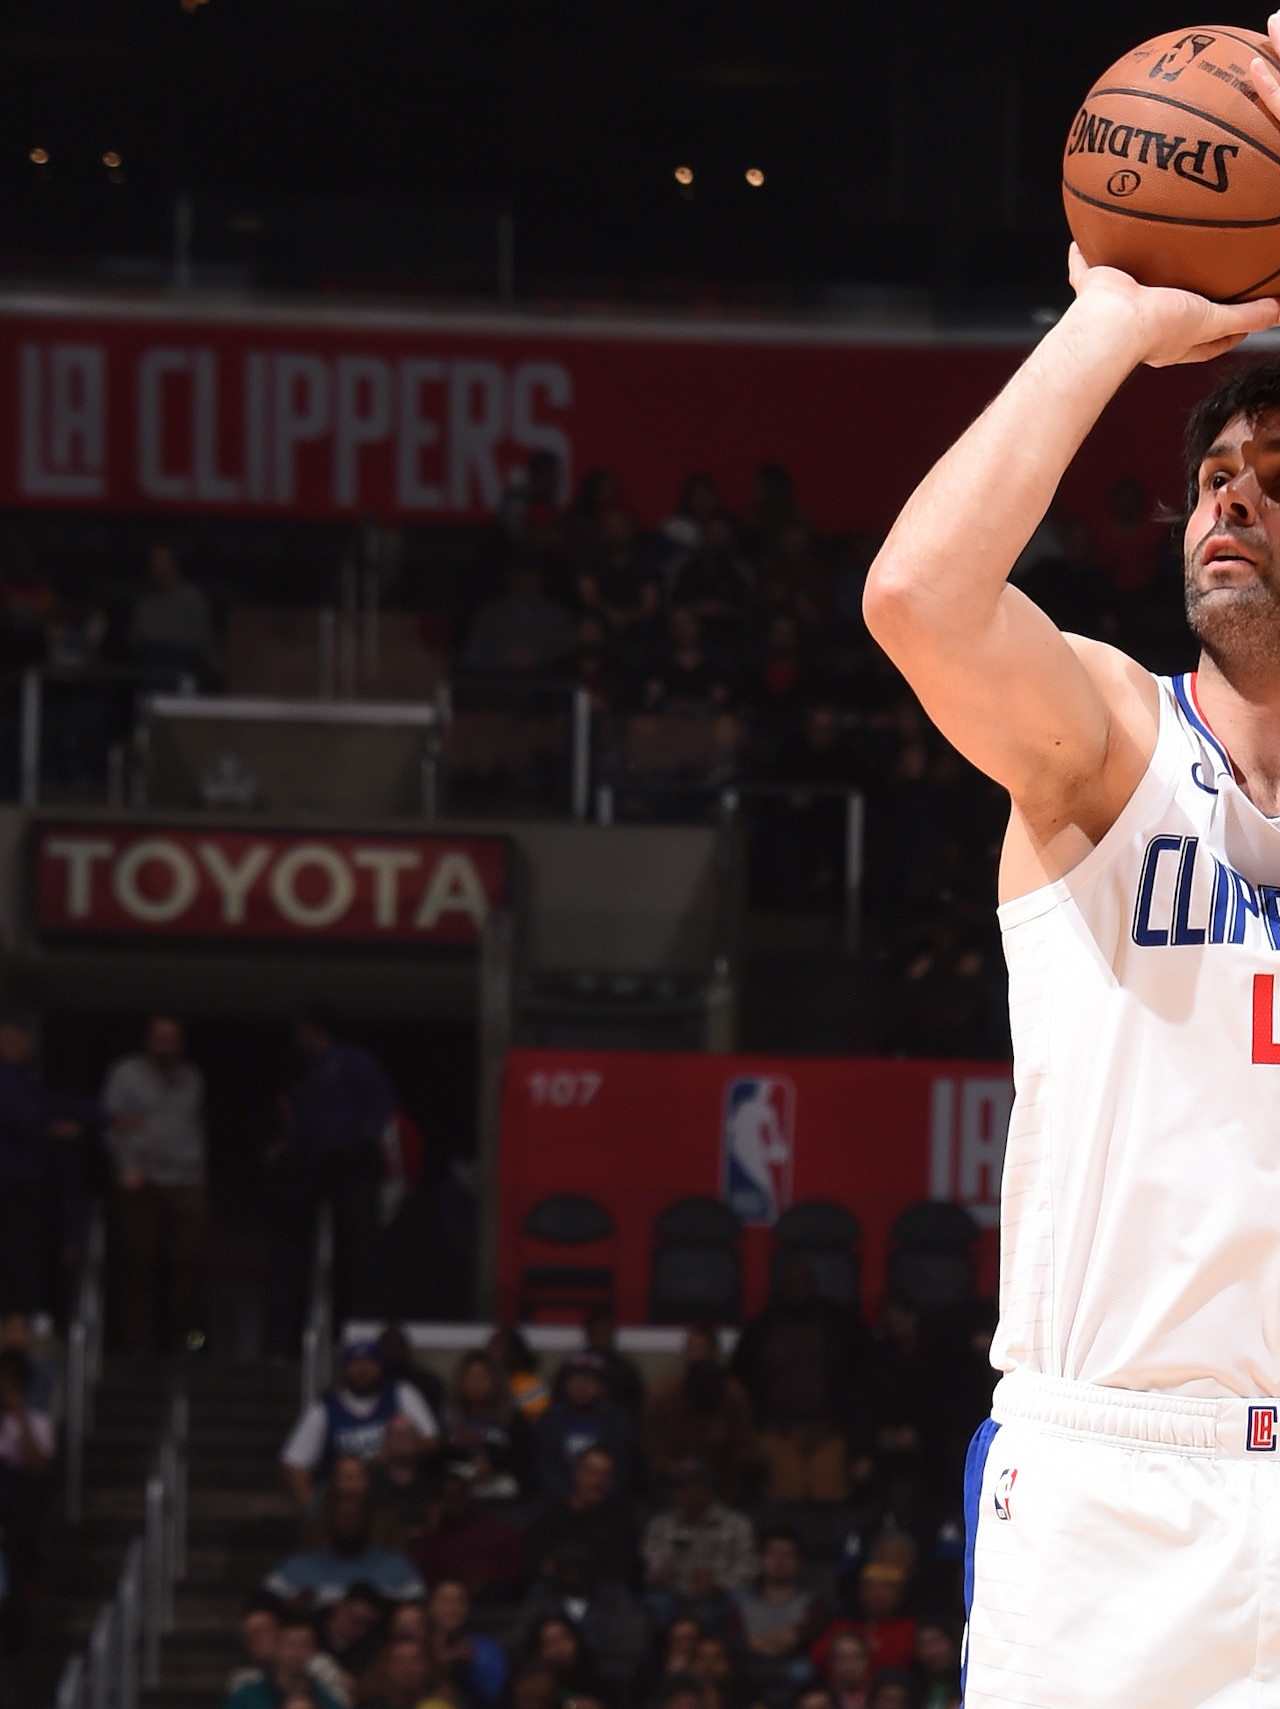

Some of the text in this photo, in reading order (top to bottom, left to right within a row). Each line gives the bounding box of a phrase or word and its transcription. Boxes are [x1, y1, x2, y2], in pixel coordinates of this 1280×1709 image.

[1067, 108, 1239, 194] SPALDING
[19, 344, 572, 512] LA CLIPPERS
[46, 838, 489, 931] TOYOTA
[527, 1070, 604, 1107] 107
